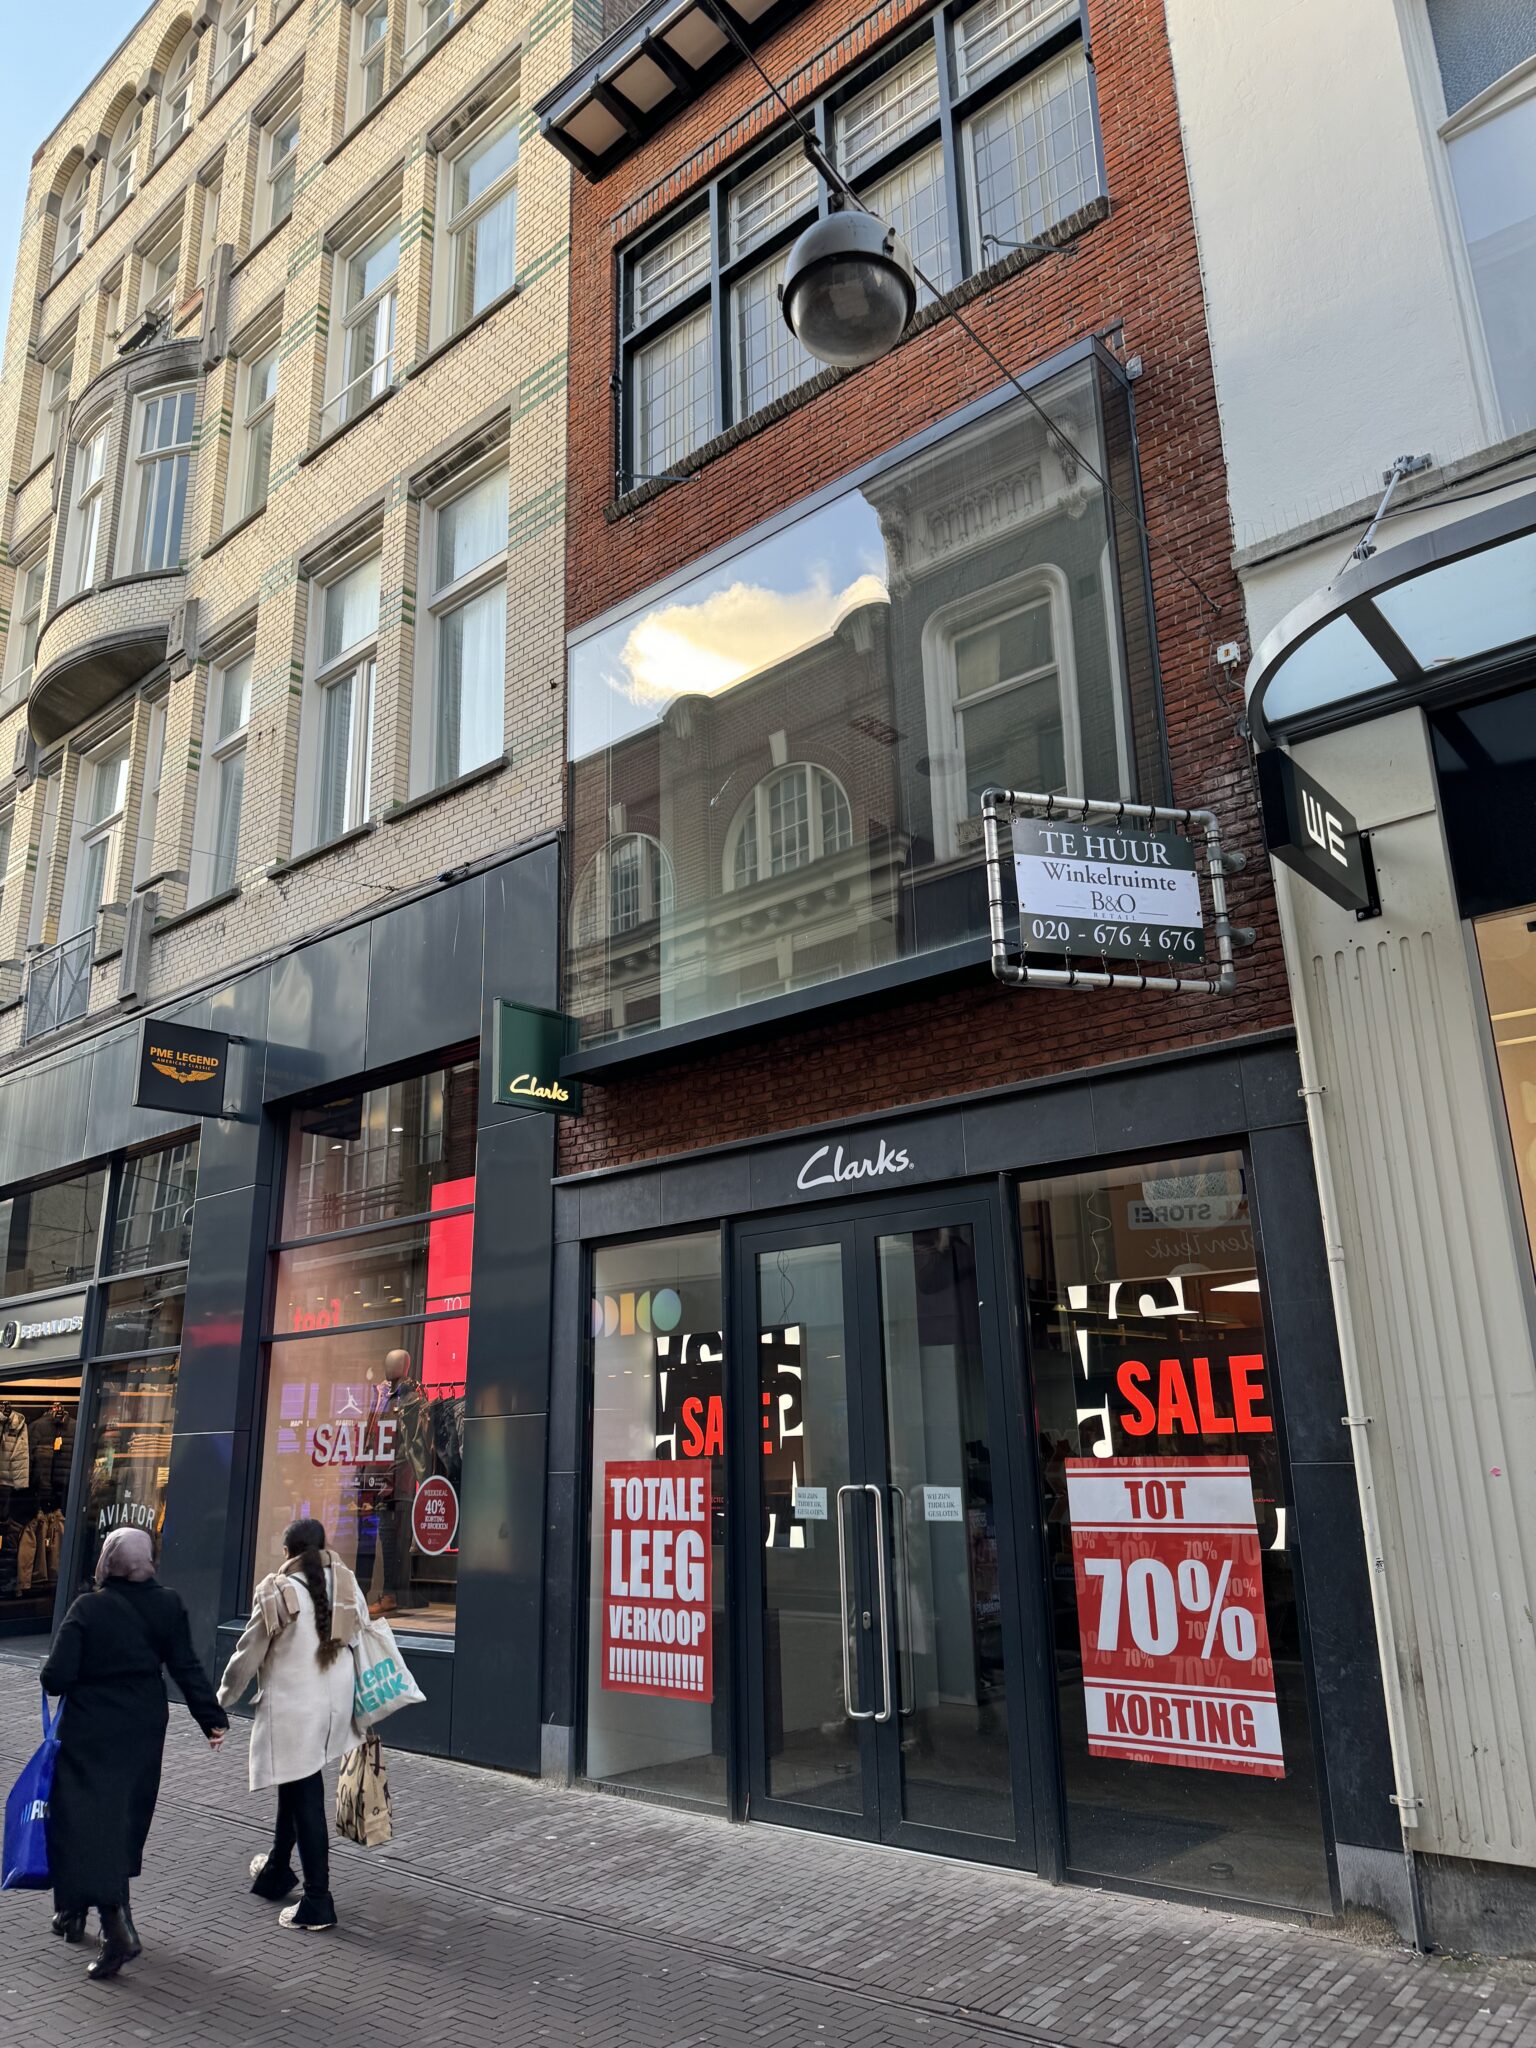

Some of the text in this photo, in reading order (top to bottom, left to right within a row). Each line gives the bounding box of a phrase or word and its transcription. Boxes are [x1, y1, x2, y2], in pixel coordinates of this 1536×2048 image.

[1302, 789, 1348, 868] WE
[1038, 830, 1172, 866] TE HUUR
[1041, 861, 1177, 892] Winkelruimte
[1090, 890, 1137, 914] B&O
[1093, 912, 1137, 921] RETAIL
[1032, 919, 1070, 941] 020
[1093, 923, 1132, 947] 676
[1138, 927, 1151, 948] 4
[1158, 929, 1196, 951] 676
[150, 1046, 219, 1067] PME LEGEND
[156, 1058, 187, 1067] AMERICAN
[509, 1073, 569, 1102] Clarks
[796, 1139, 910, 1190] Clarks
[1116, 1354, 1274, 1436] SALE
[312, 1420, 397, 1467] SALE
[98, 1503, 156, 1530] AVIATOR
[425, 1499, 446, 1515] 40%
[610, 1477, 705, 1522] TOTALE
[1124, 1480, 1187, 1520] TOT
[610, 1528, 705, 1602] LEEG
[1184, 1540, 1218, 1560] 70%
[609, 1604, 706, 1646] VERKOOP
[1083, 1557, 1258, 1662] 70%
[1104, 1692, 1257, 1748] KORTING
